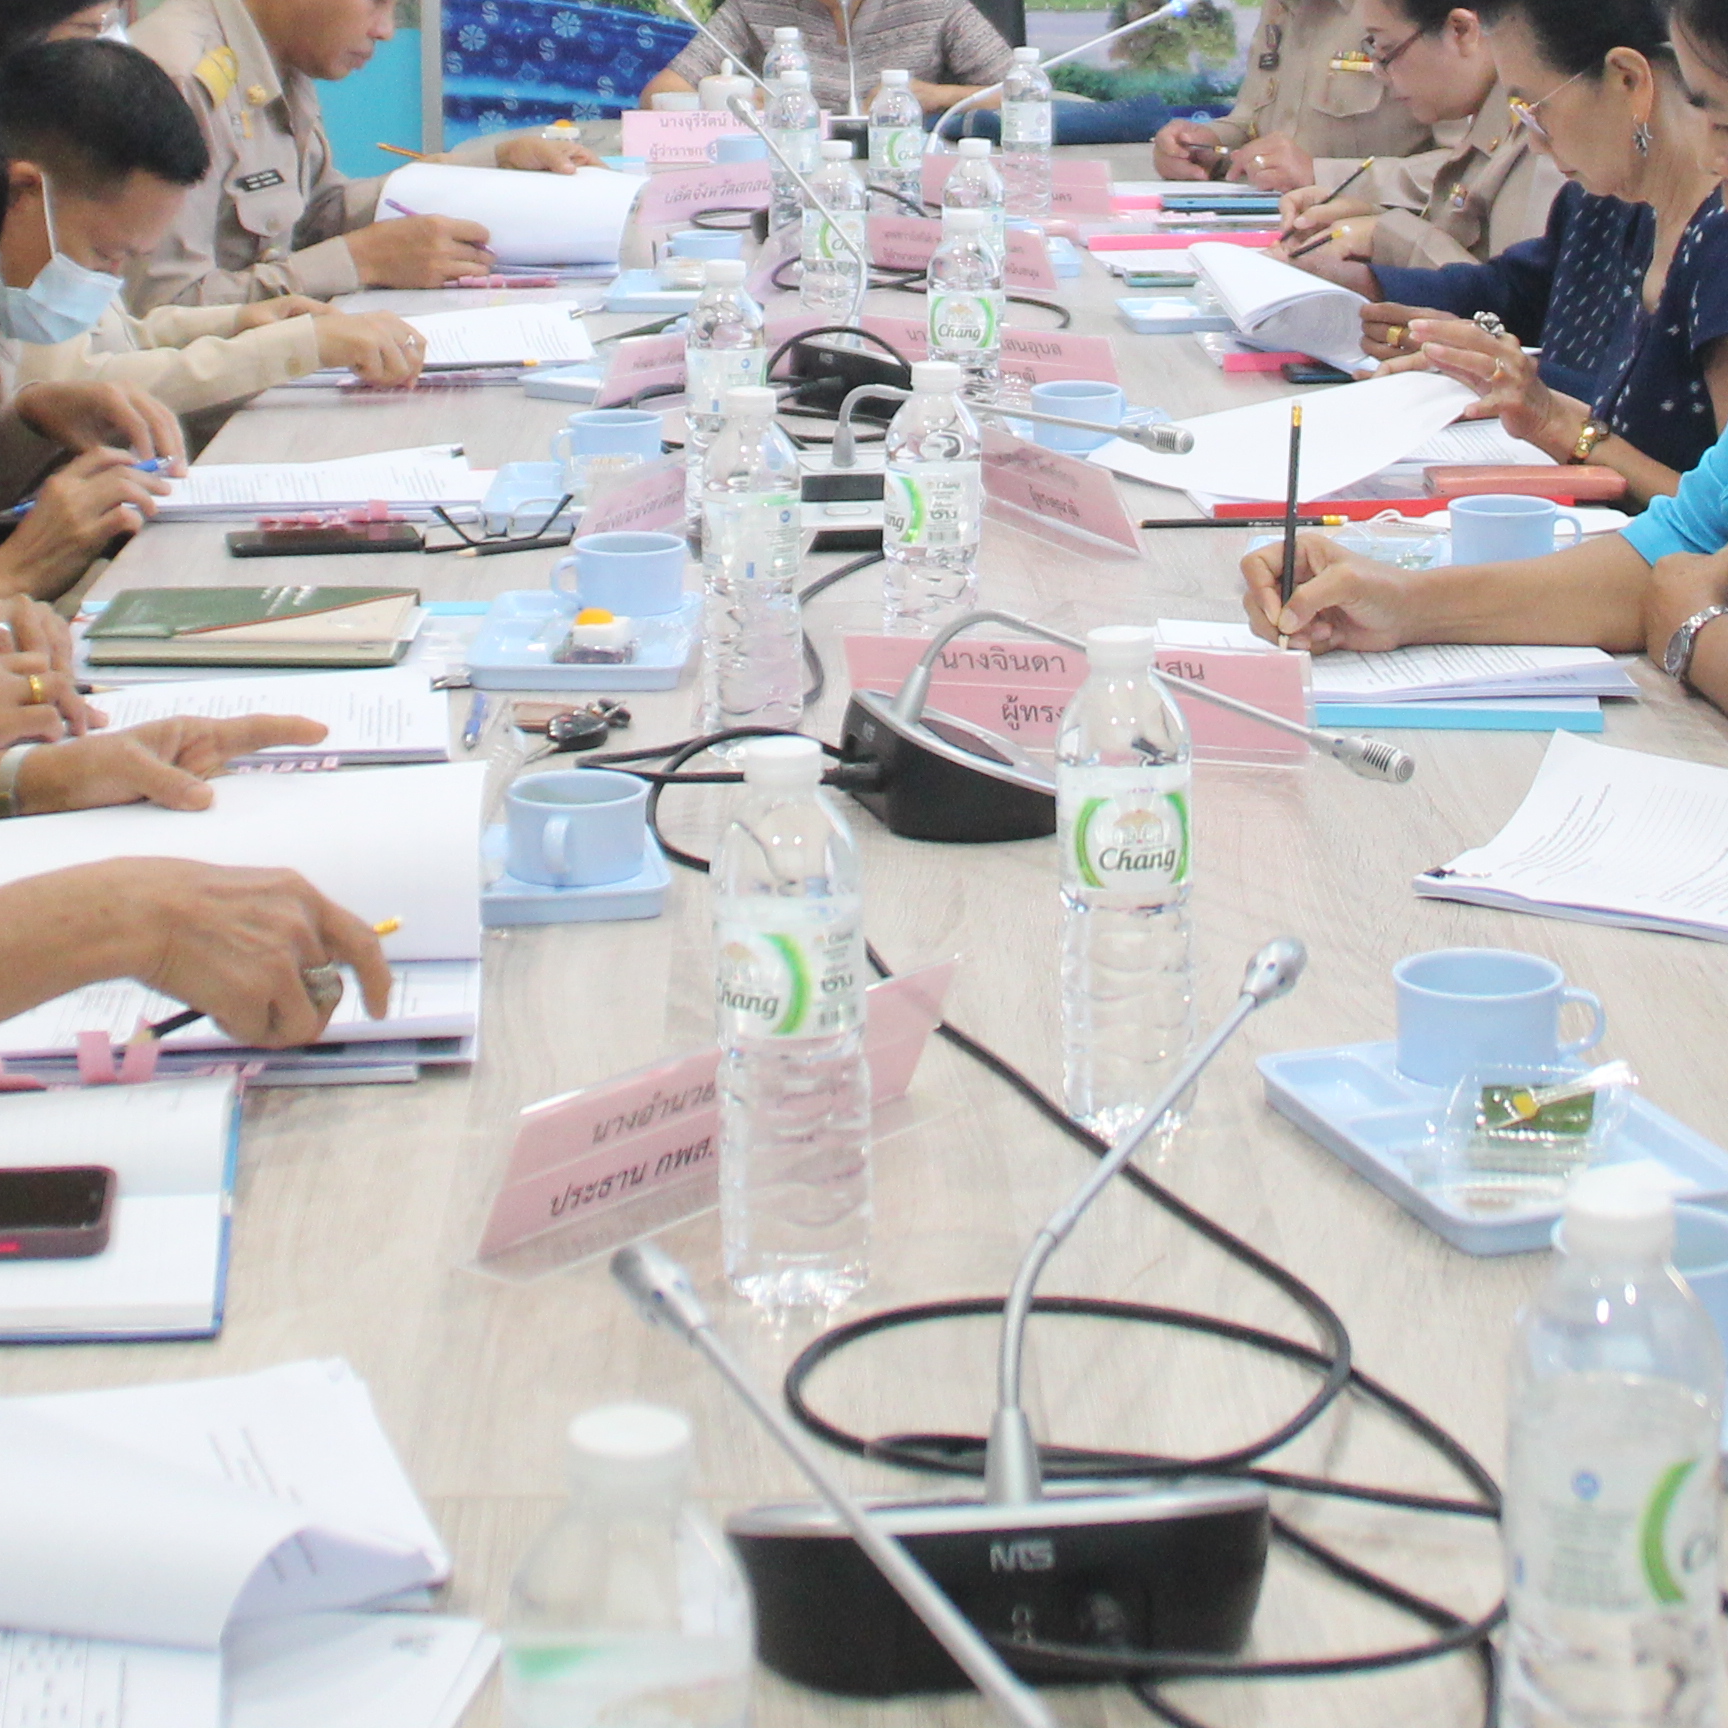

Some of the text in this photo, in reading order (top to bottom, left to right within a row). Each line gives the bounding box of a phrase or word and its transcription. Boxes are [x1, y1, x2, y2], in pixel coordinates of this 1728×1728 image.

[937, 323, 982, 340] Chang
[939, 646, 1066, 673] นางจินดา
[1099, 847, 1176, 872] Chang
[550, 1160, 648, 1217] ประธาน
